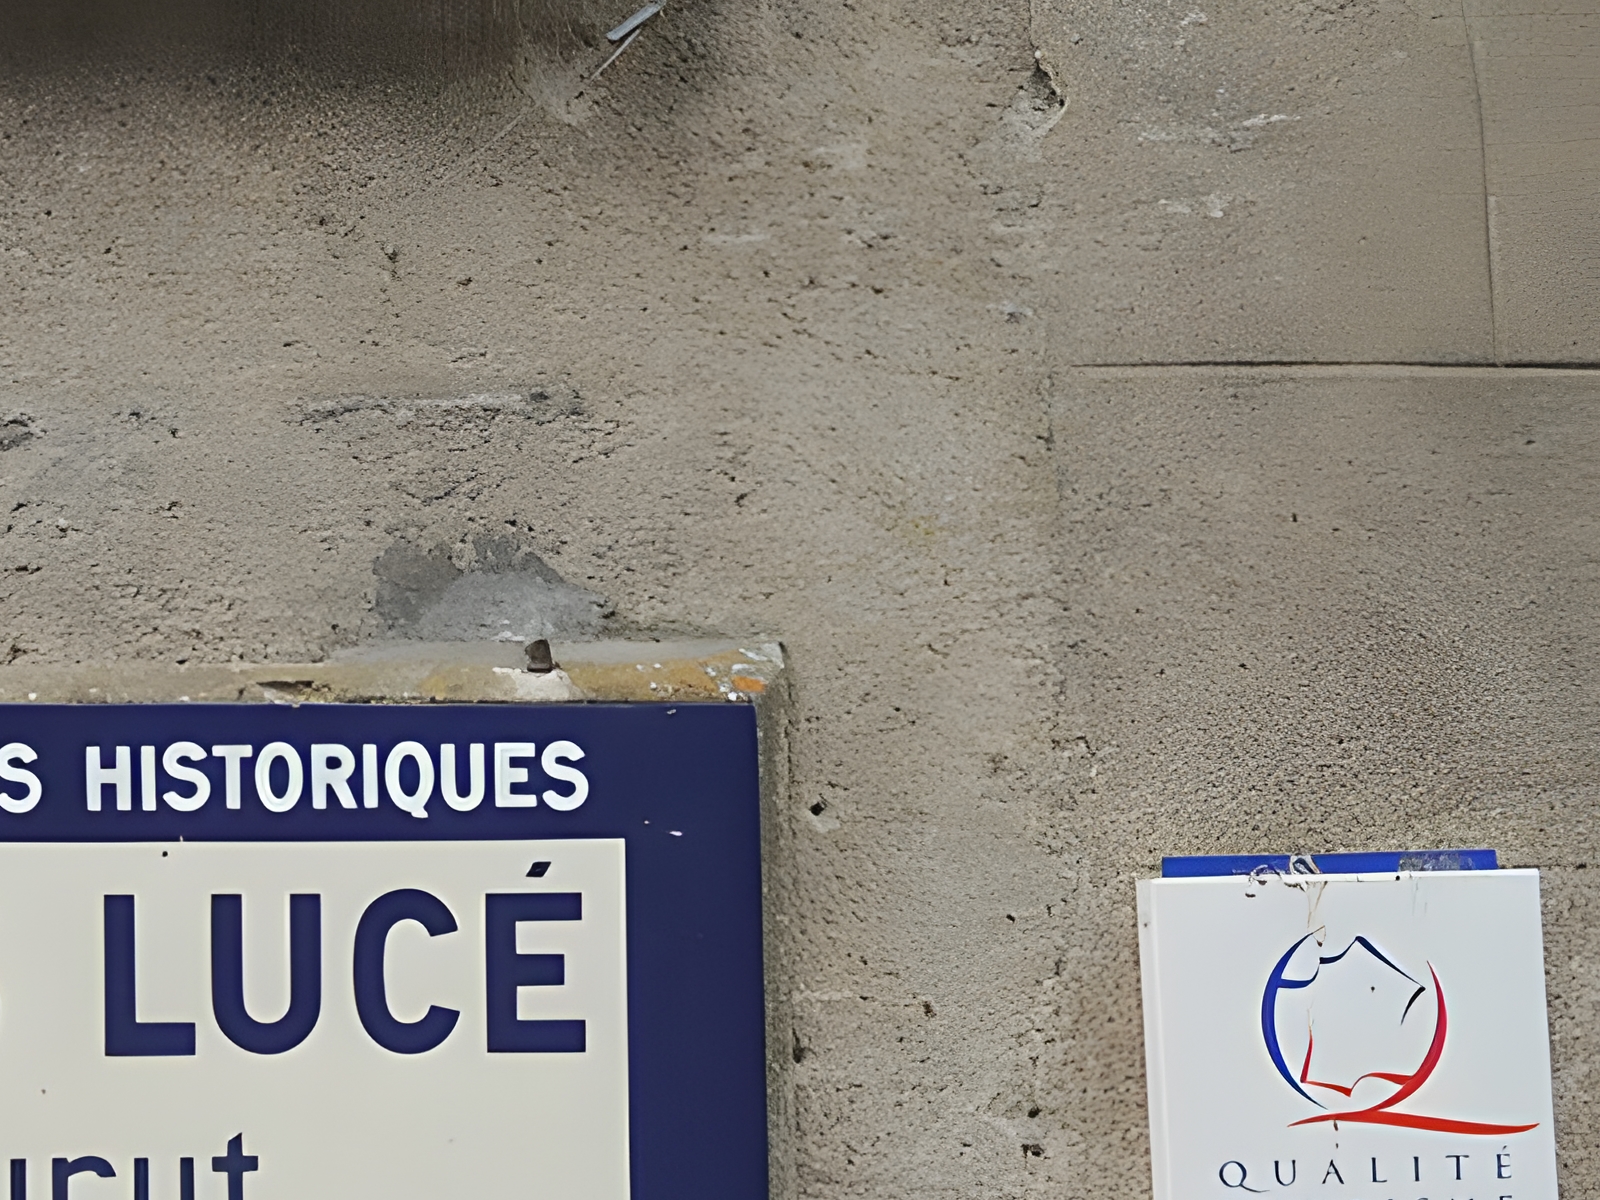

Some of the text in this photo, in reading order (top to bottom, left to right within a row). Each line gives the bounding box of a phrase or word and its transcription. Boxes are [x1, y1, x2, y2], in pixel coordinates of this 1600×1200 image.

[86, 740, 589, 818] HISTORIQUES
[103, 861, 587, 1057] LUCÉ
[1218, 1145, 1513, 1194] QUALITÉ
